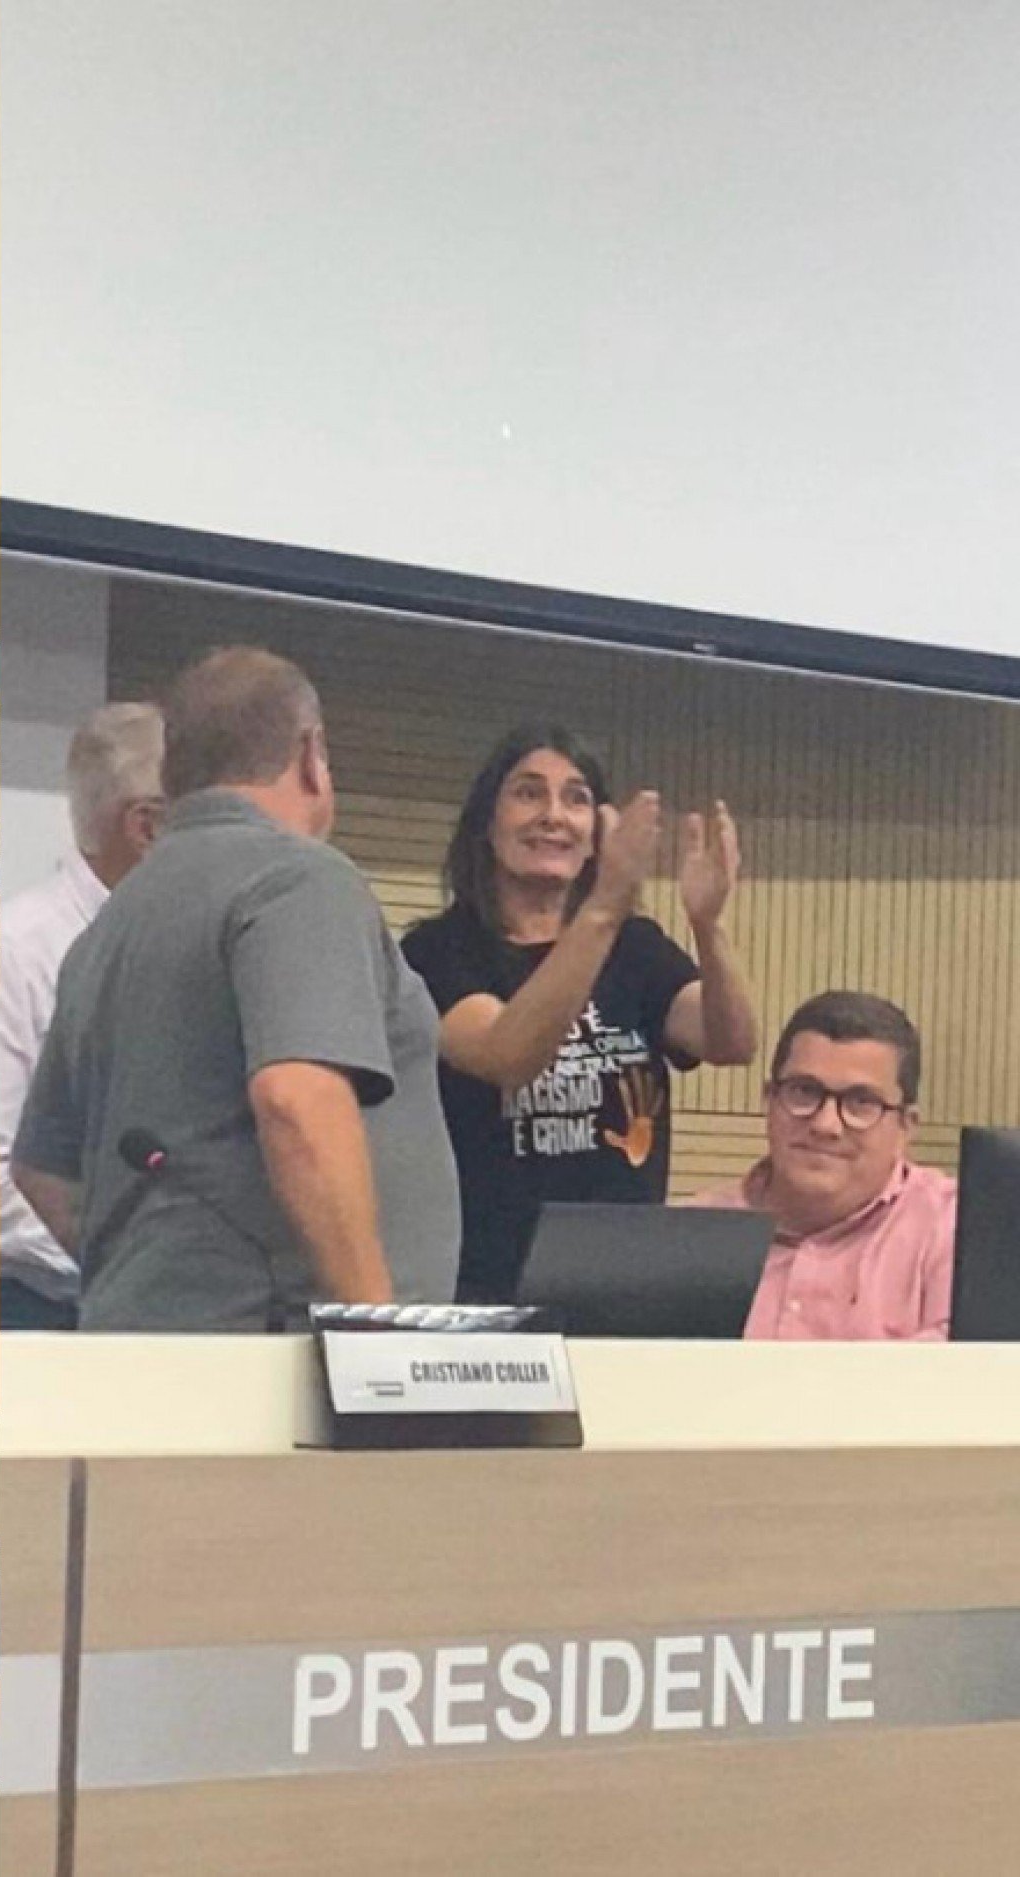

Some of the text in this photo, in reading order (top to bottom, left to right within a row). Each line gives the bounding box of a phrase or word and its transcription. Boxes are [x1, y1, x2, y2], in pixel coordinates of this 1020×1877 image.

[533, 1114, 599, 1157] CRIME
[410, 1361, 493, 1384] CRISTIANO
[293, 1627, 875, 1755] PRESIDENTE
